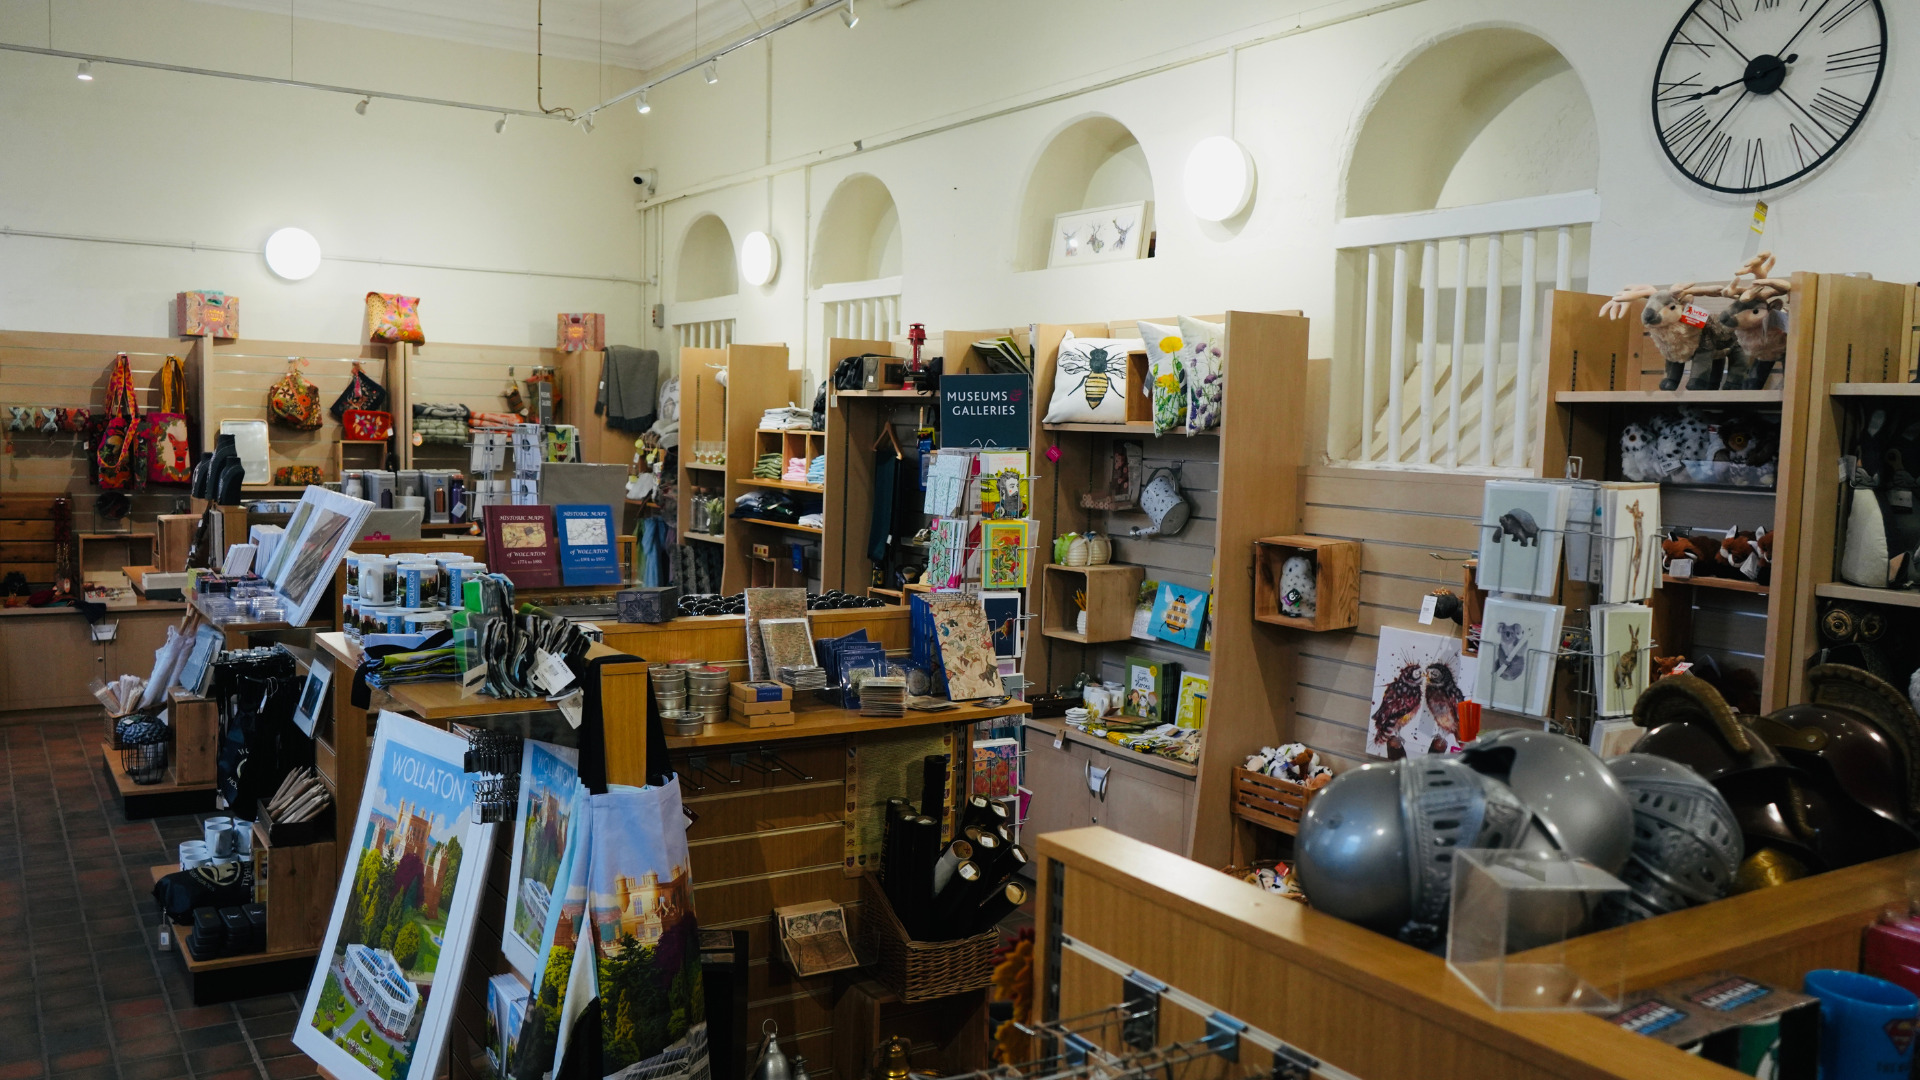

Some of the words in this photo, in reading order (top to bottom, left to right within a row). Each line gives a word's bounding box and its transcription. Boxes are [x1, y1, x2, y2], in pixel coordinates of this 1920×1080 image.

[946, 391, 1008, 402] MUSEUMS
[952, 405, 1016, 416] GALLERIES
[392, 751, 467, 804] WOLLATON
[537, 752, 575, 790] WOLLATON
